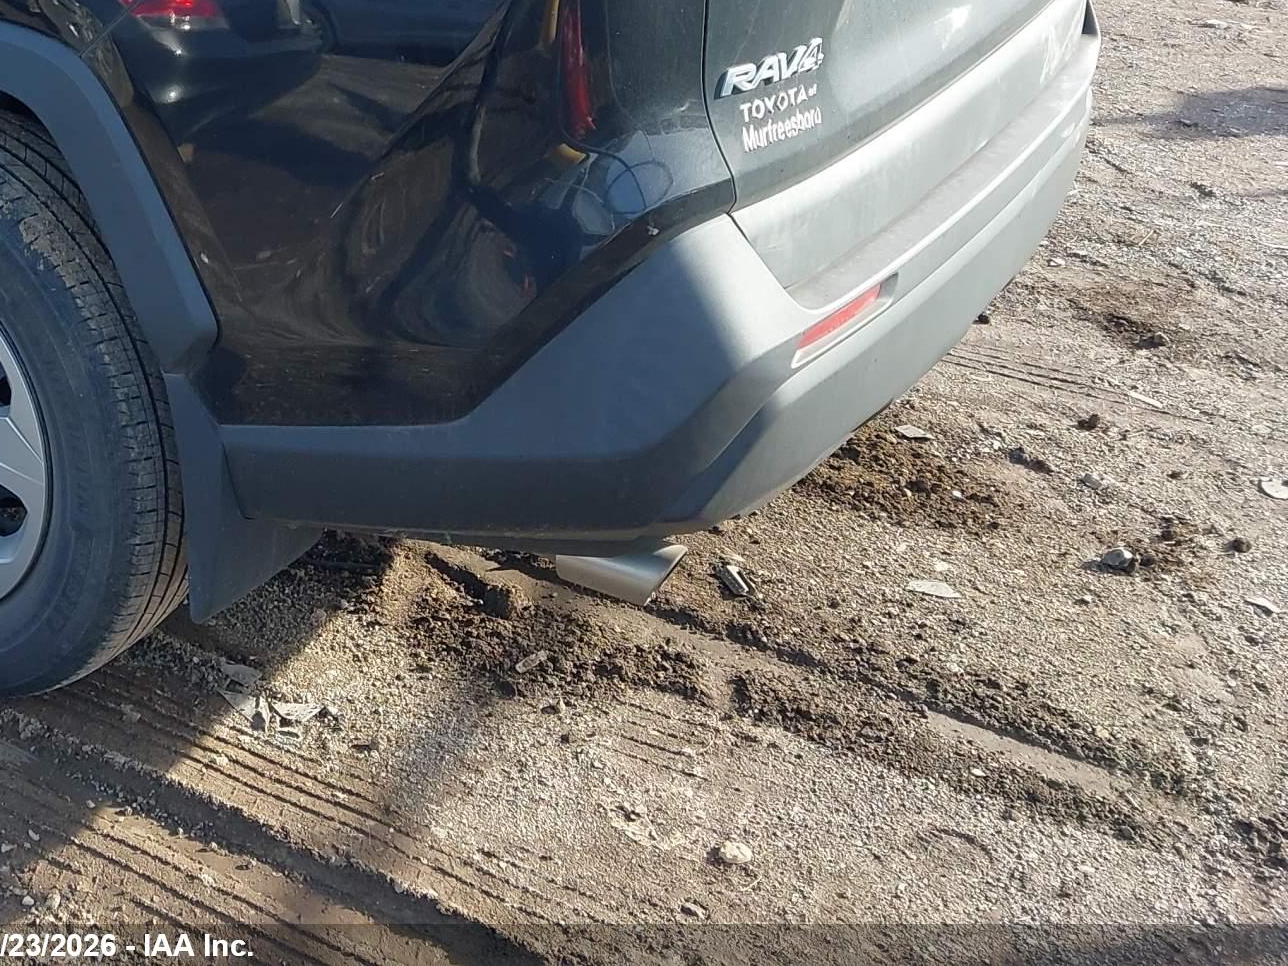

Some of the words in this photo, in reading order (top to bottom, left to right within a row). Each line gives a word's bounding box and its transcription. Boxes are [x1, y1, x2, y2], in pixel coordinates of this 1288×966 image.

[715, 37, 824, 99] RAV4
[739, 84, 808, 123] TOYOTA
[742, 106, 822, 153] Murfreesboro
